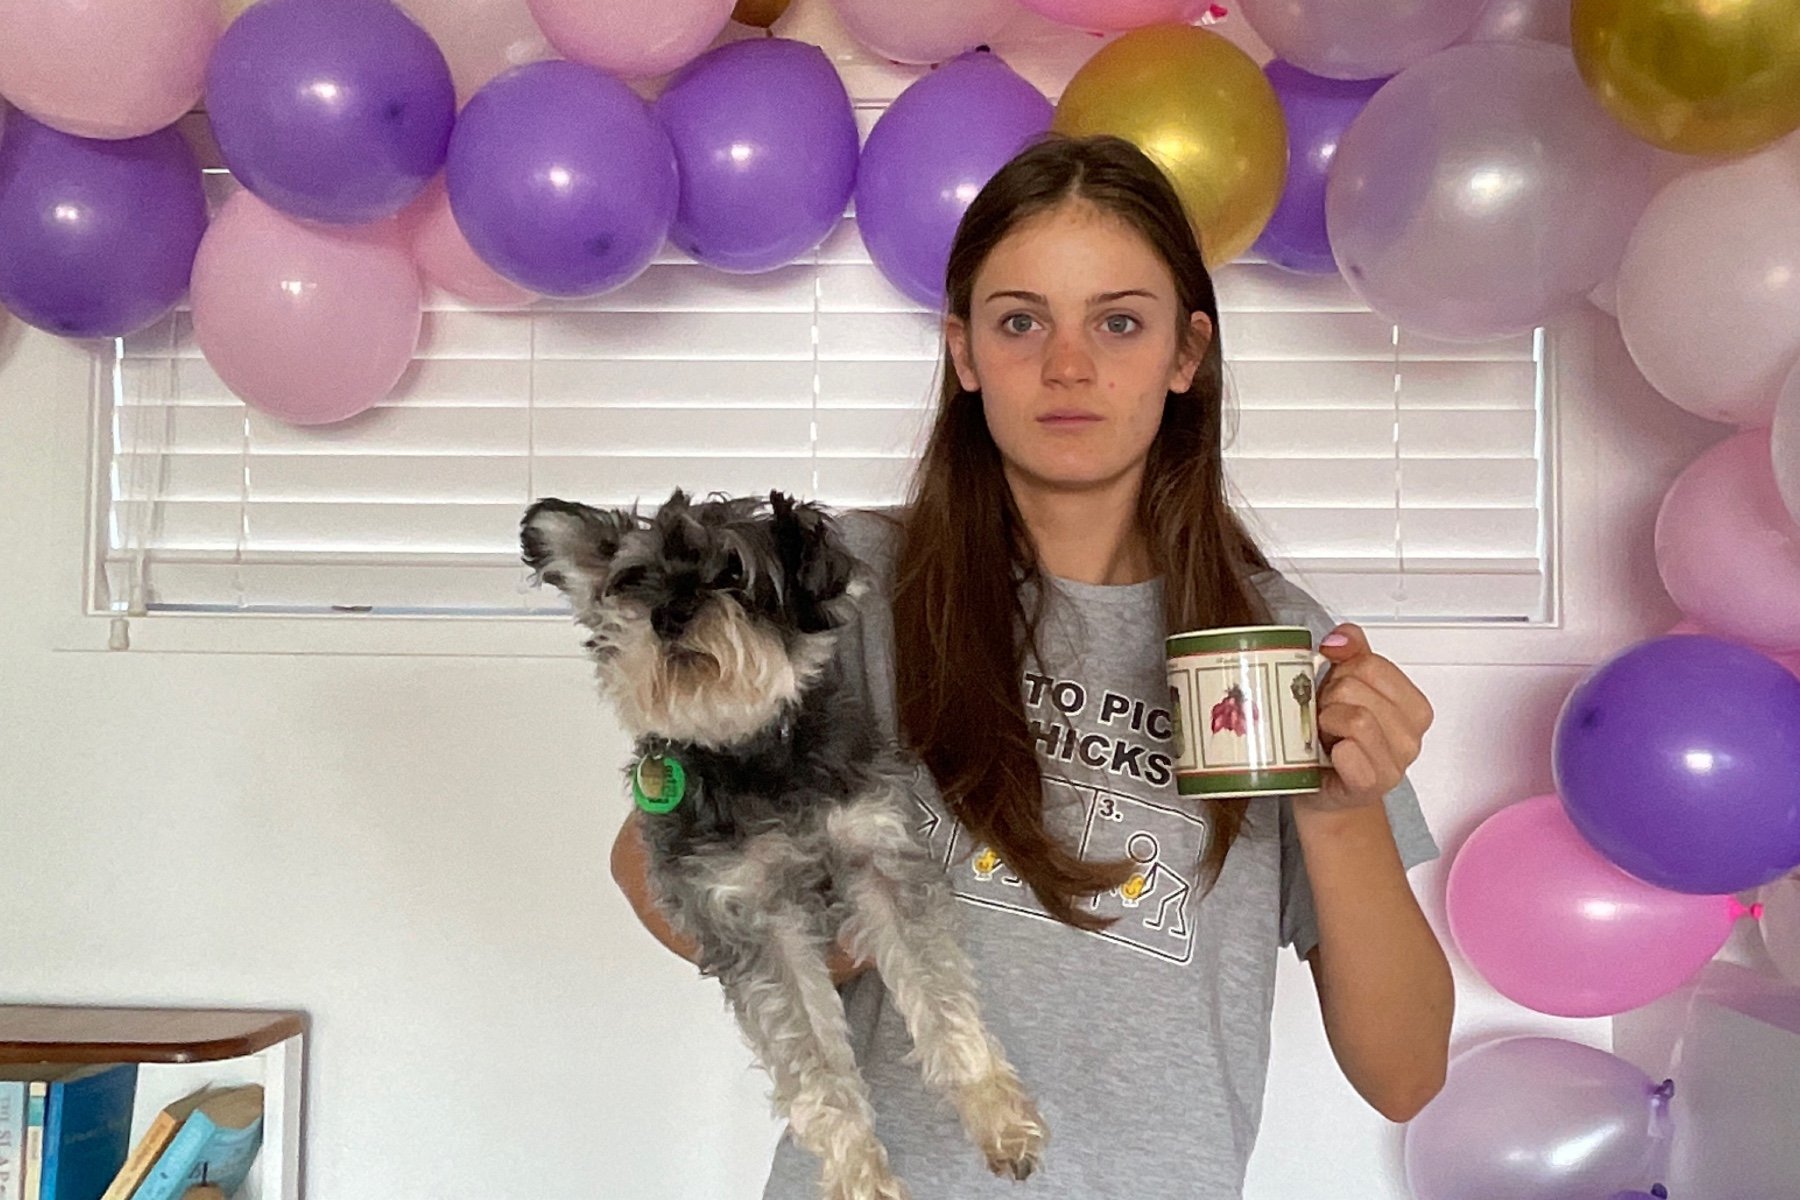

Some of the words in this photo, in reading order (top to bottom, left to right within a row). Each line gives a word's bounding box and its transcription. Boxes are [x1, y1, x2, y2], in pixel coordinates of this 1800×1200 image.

[1024, 671, 1086, 715] TO
[1099, 690, 1172, 741] PIC
[1031, 719, 1172, 787] HICKS
[1100, 798, 1122, 821] 3.
